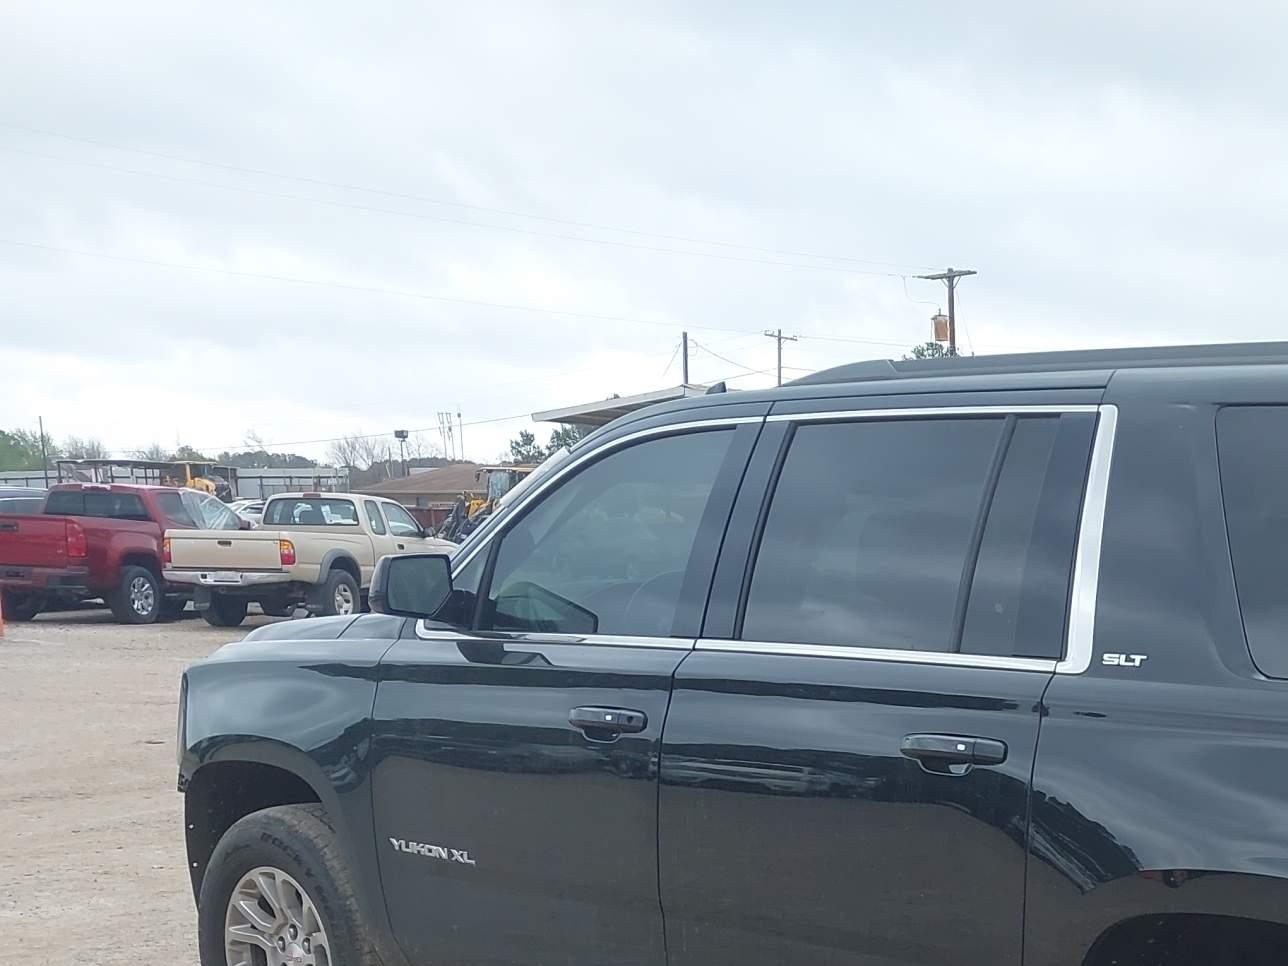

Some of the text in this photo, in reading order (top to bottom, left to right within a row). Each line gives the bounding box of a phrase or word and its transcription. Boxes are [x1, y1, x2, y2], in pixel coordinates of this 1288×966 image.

[1102, 653, 1148, 667] SLT
[389, 838, 476, 867] YUKON XL
